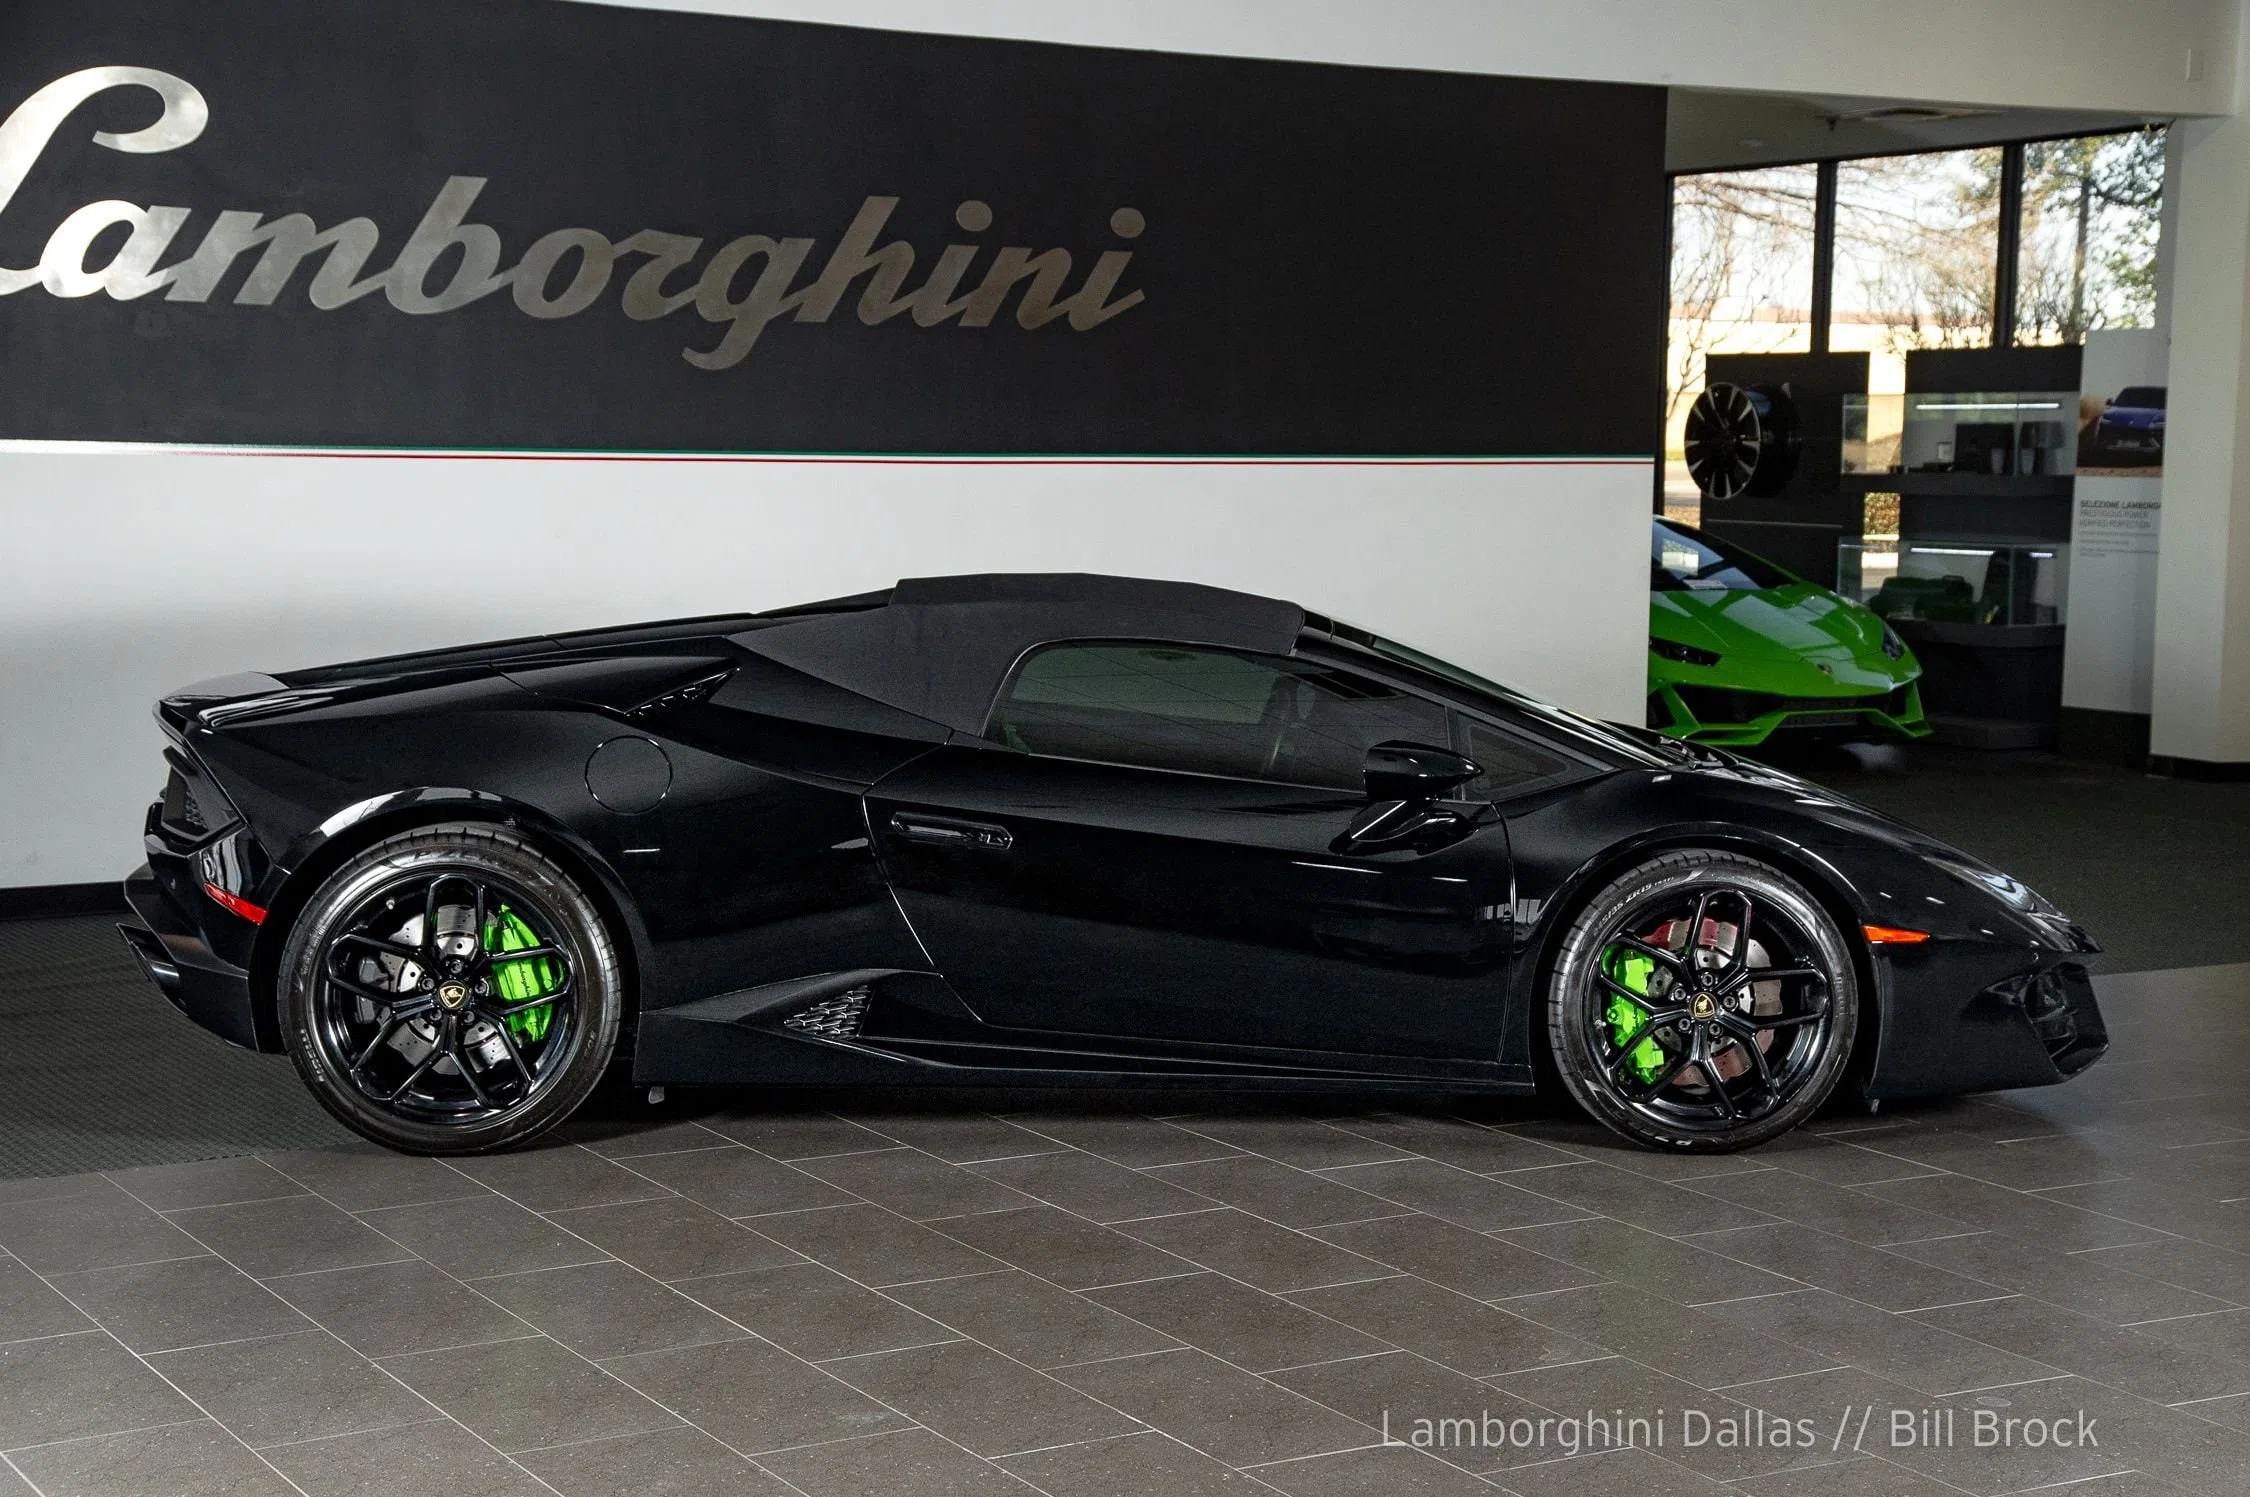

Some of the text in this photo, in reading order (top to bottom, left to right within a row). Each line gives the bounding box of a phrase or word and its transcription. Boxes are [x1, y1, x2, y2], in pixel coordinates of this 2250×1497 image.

[0, 65, 1147, 371] Lamborghini
[2122, 501, 2161, 509] LAMBORG
[517, 960, 531, 998] mborghin
